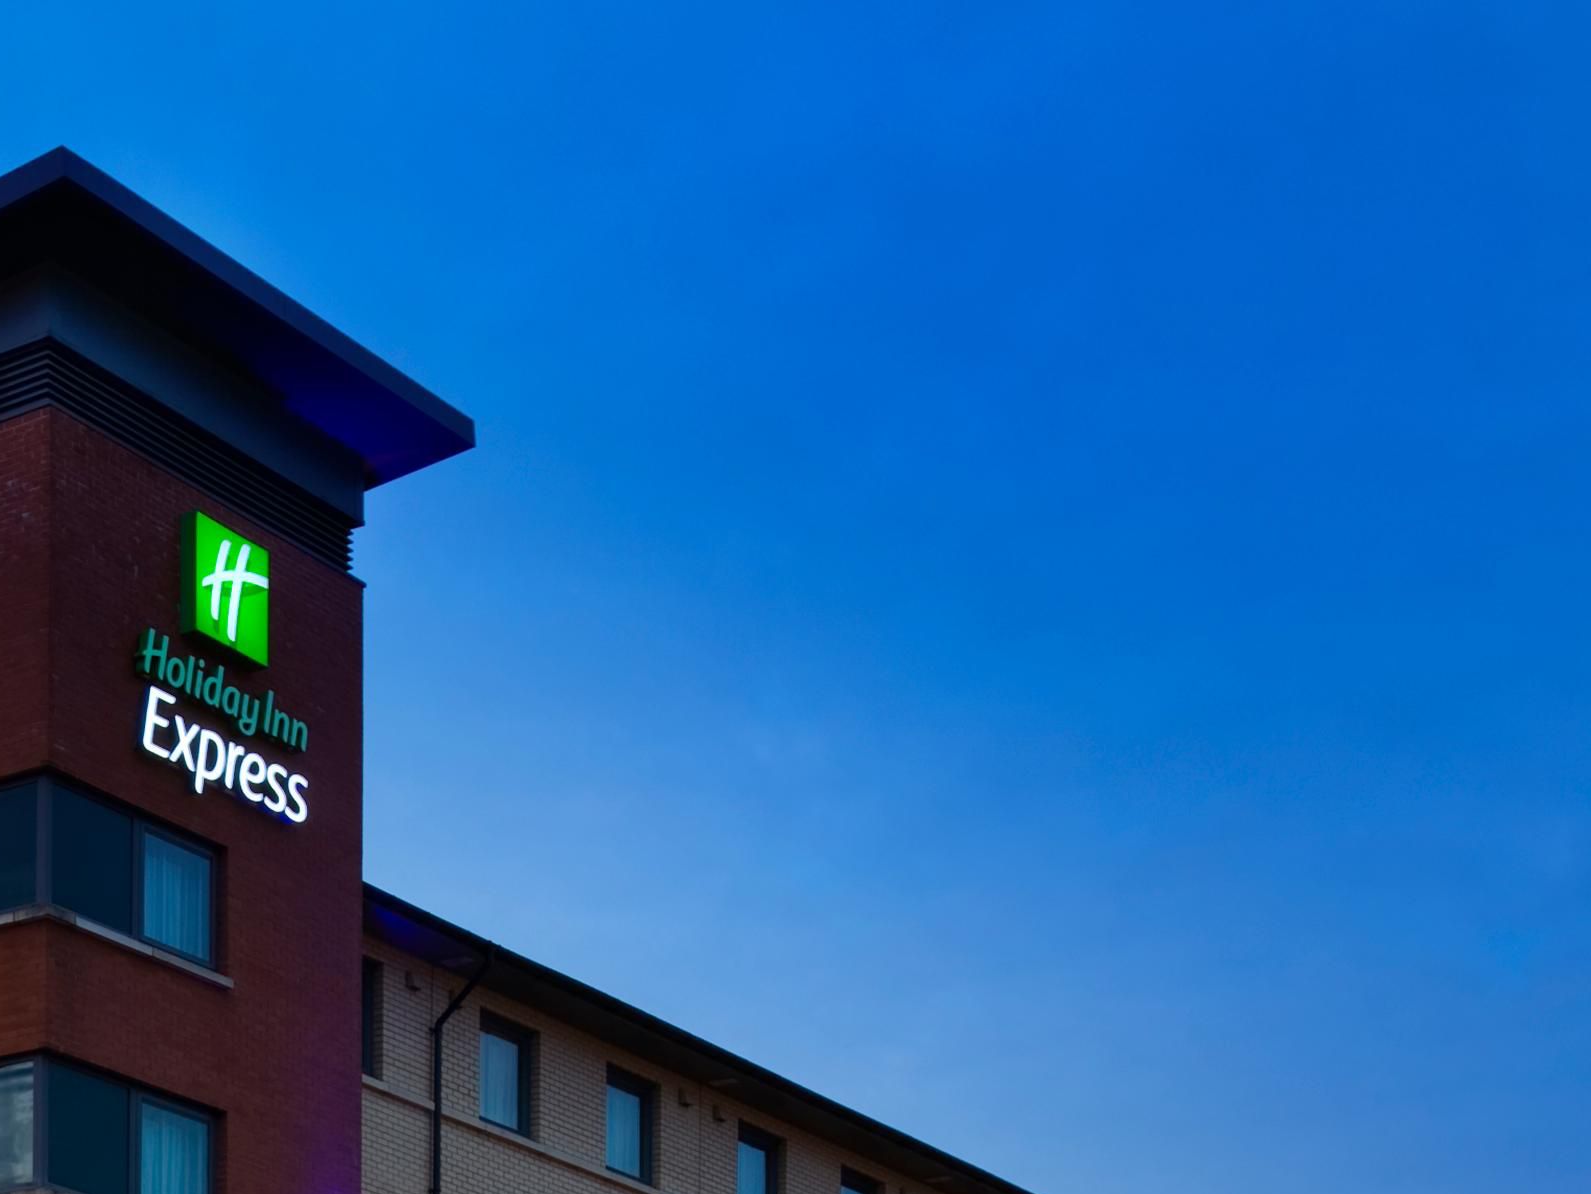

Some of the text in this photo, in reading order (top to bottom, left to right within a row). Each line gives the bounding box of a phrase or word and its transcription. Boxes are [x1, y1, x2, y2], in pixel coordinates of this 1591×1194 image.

[141, 628, 308, 752] Holiday Inn
[142, 685, 308, 823] Express
